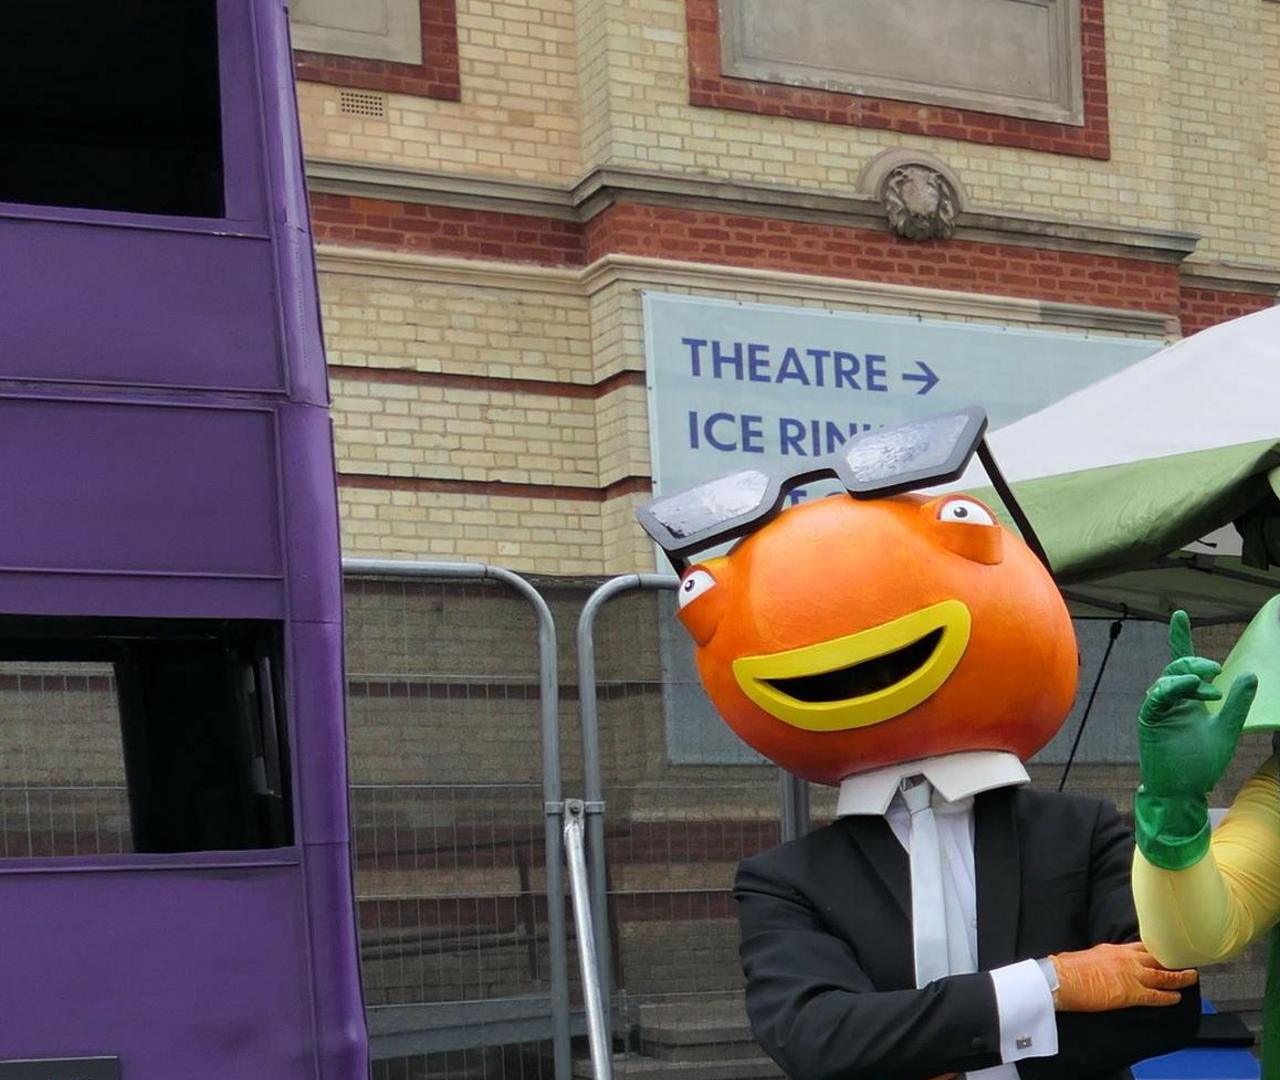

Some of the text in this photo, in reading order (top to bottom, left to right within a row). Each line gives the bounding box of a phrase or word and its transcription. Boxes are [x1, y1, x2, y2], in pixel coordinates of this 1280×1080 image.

[682, 338, 888, 391] THEATRE
[689, 411, 884, 456] ICE RIN
